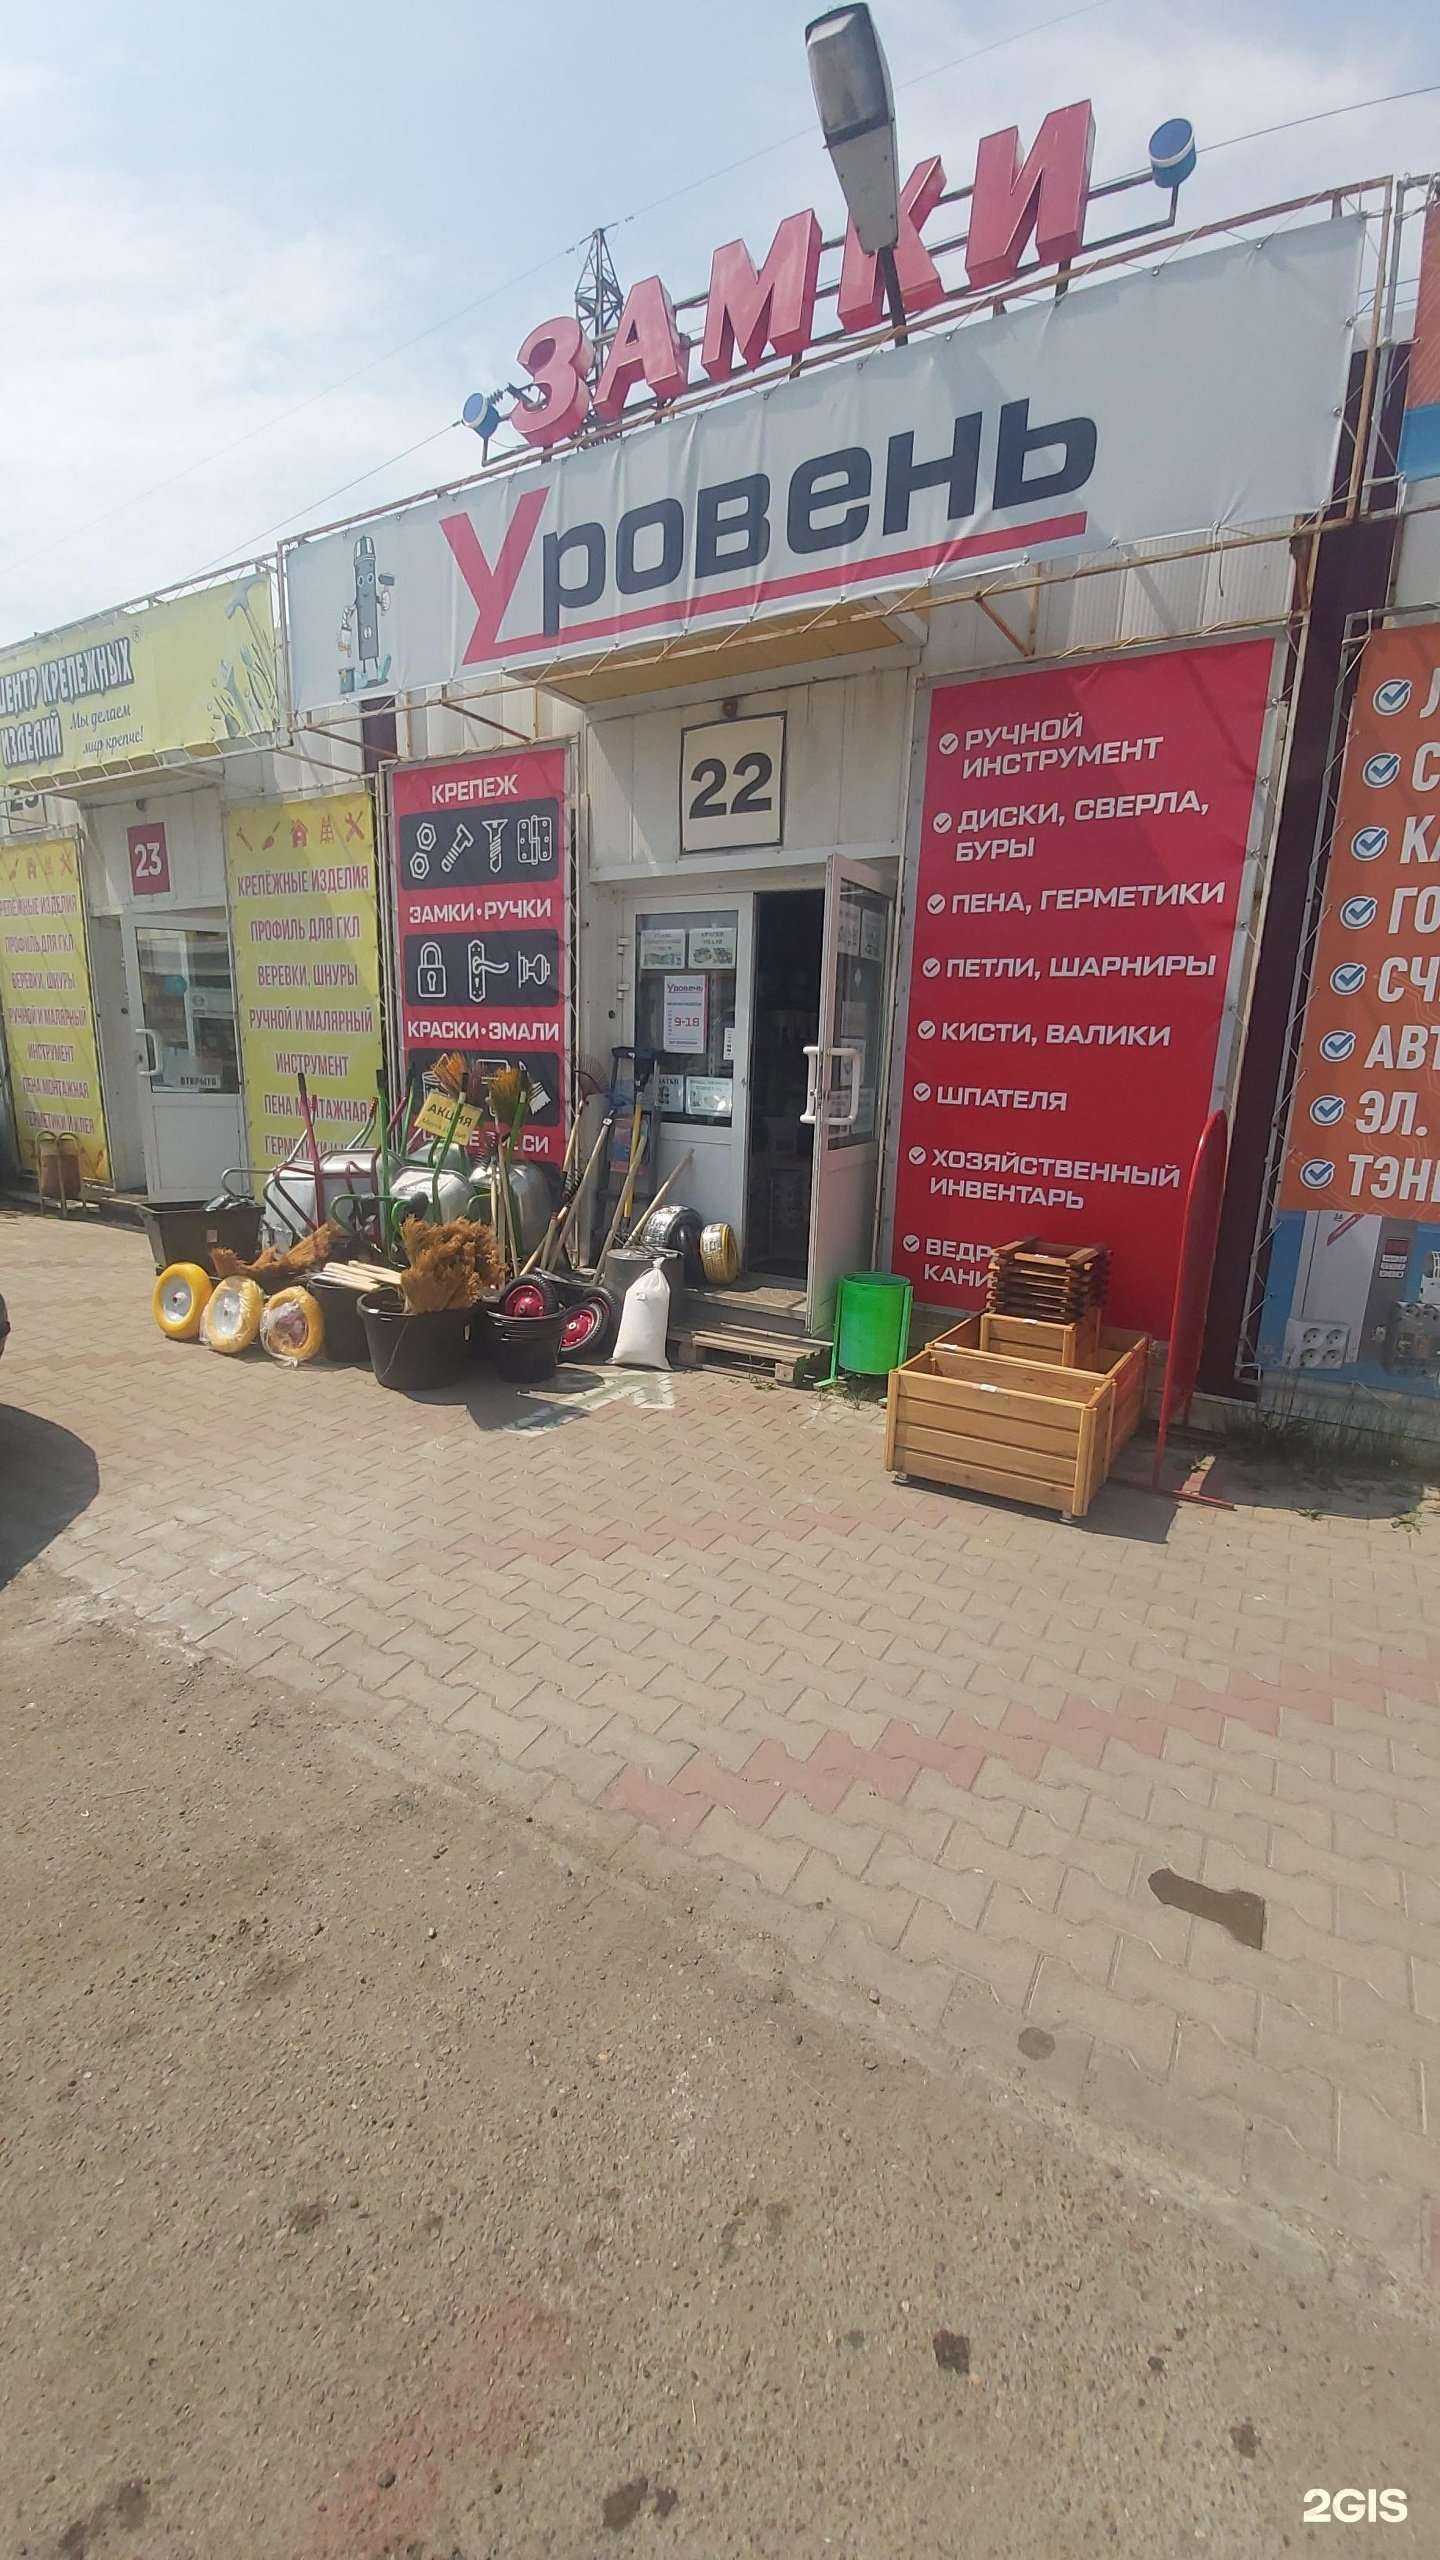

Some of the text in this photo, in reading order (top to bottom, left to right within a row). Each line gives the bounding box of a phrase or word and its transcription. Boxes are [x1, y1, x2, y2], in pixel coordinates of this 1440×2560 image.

[511, 99, 1095, 446] ЗАМКИ
[439, 397, 1097, 665] Уровень
[70, 703, 131, 732] Мы делаем
[965, 711, 1083, 750] РУЧНОЙ
[0, 708, 63, 769] ИЗДЕЛИЙ
[962, 736, 1164, 779] ИНСТРУМЕНТ
[432, 774, 518, 804] КРЕПЕЖ
[689, 752, 772, 819] 22
[957, 790, 1209, 833] ДИСКИ, СВЕРЛА,
[956, 838, 1035, 862] БУРЫ
[1400, 815, 1440, 864] К
[134, 842, 162, 878] 23
[311, 865, 369, 894] ИЗДЕЛИЯ
[409, 898, 552, 924] ЗАМКИ РУЧКИ
[951, 882, 1226, 915] ПЕНА, ГЕРМЕТИКИ
[251, 915, 361, 943] ПРОФИЛЬ ДЛЯ ГКЛ
[313, 963, 358, 986] ШНУРЫ
[946, 955, 1217, 981] ПЕТЛИ, ШАРНИРЫ
[1378, 957, 1440, 1003] СЧ
[250, 1005, 373, 1032] РУЧНОЙ И МАЛЯРНЫЙ
[408, 1021, 559, 1041] КРАСКИ ЭМАЛИ
[674, 1016, 700, 1027] 9-18
[941, 1022, 1171, 1047] КИСТИ, ВАЛИКИ
[275, 1053, 349, 1076] ИНСТРУМЕНТ
[264, 1094, 292, 1115] ПЕНА
[937, 1086, 1067, 1111] ШПАТЕЛЯ
[1356, 1090, 1428, 1137] ЭЛ.
[932, 1149, 1181, 1188] ХОЗЯЙСТВЕННЫЙ
[930, 1177, 1084, 1210] ИНВЕНТАРЬ
[926, 1238, 998, 1264] ВЕДР
